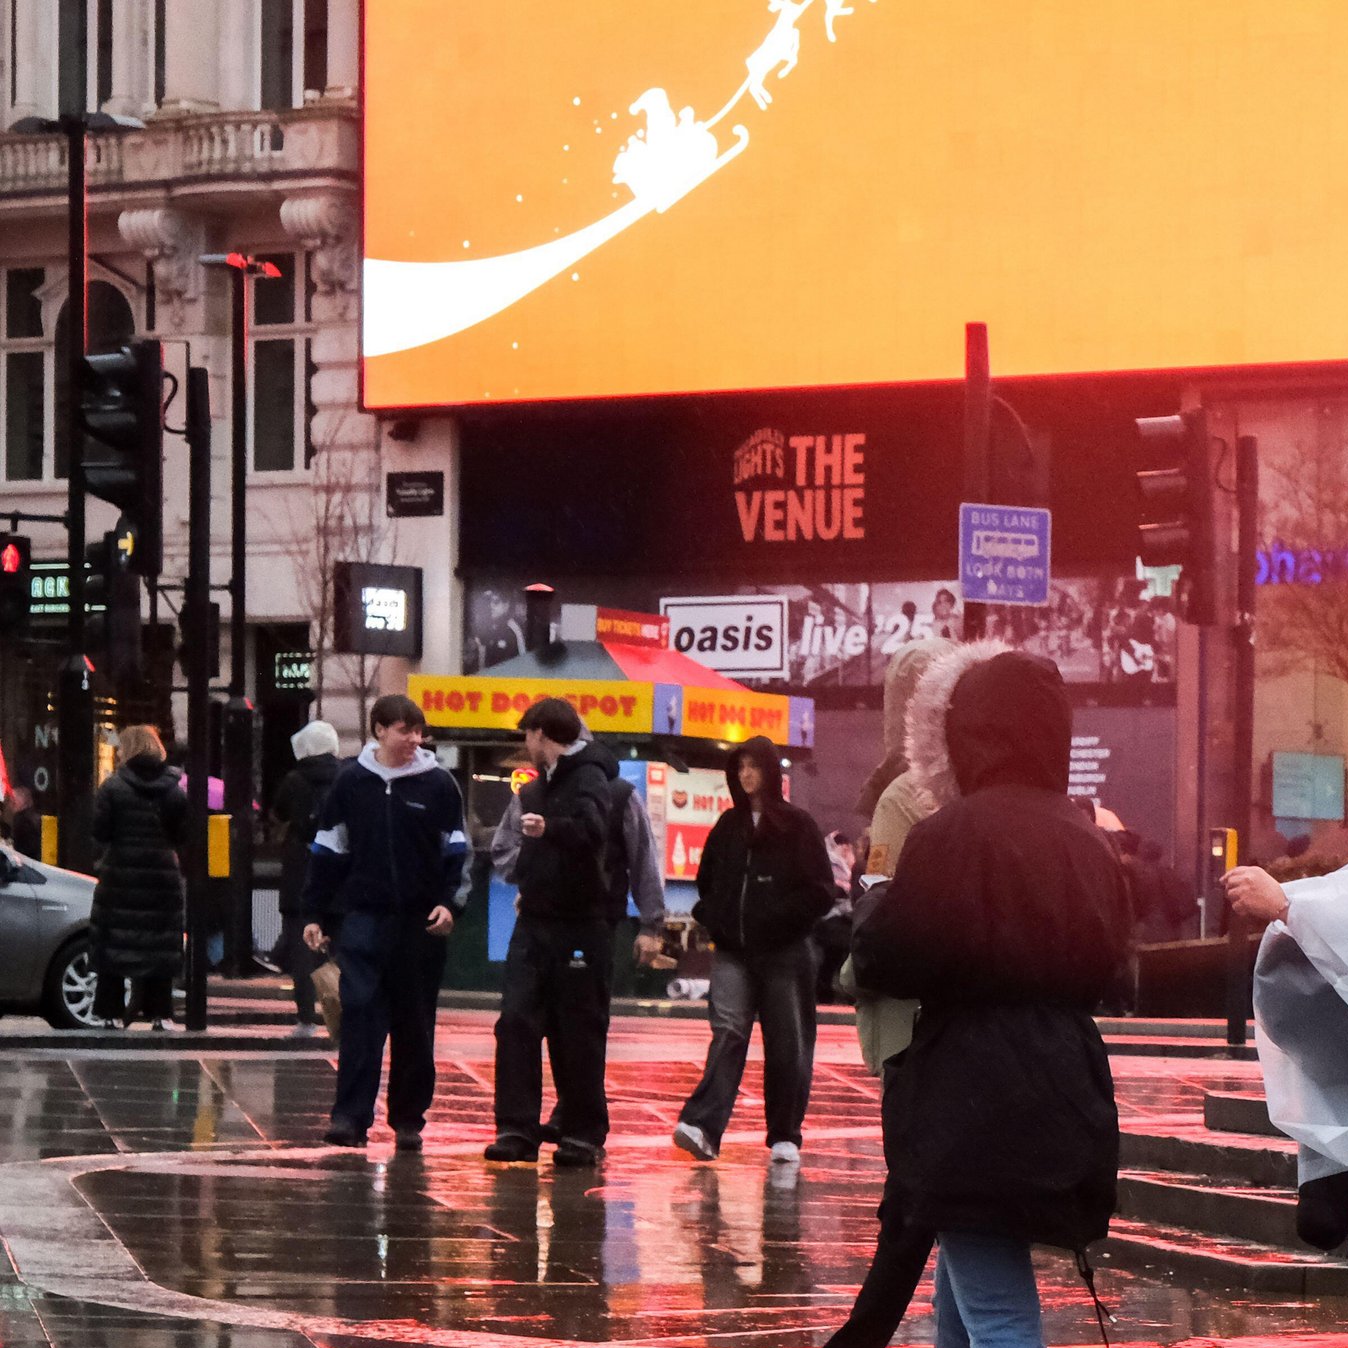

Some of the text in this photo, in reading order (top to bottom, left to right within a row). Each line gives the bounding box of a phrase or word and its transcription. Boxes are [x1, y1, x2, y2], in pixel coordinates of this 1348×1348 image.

[788, 433, 866, 486] THE
[734, 487, 866, 542] VENUE
[971, 511, 1038, 528] BUS LANE
[674, 615, 773, 652] oasis
[800, 614, 868, 656] live
[422, 689, 482, 713] HOT
[688, 700, 783, 730] HOT DOG SPOT
